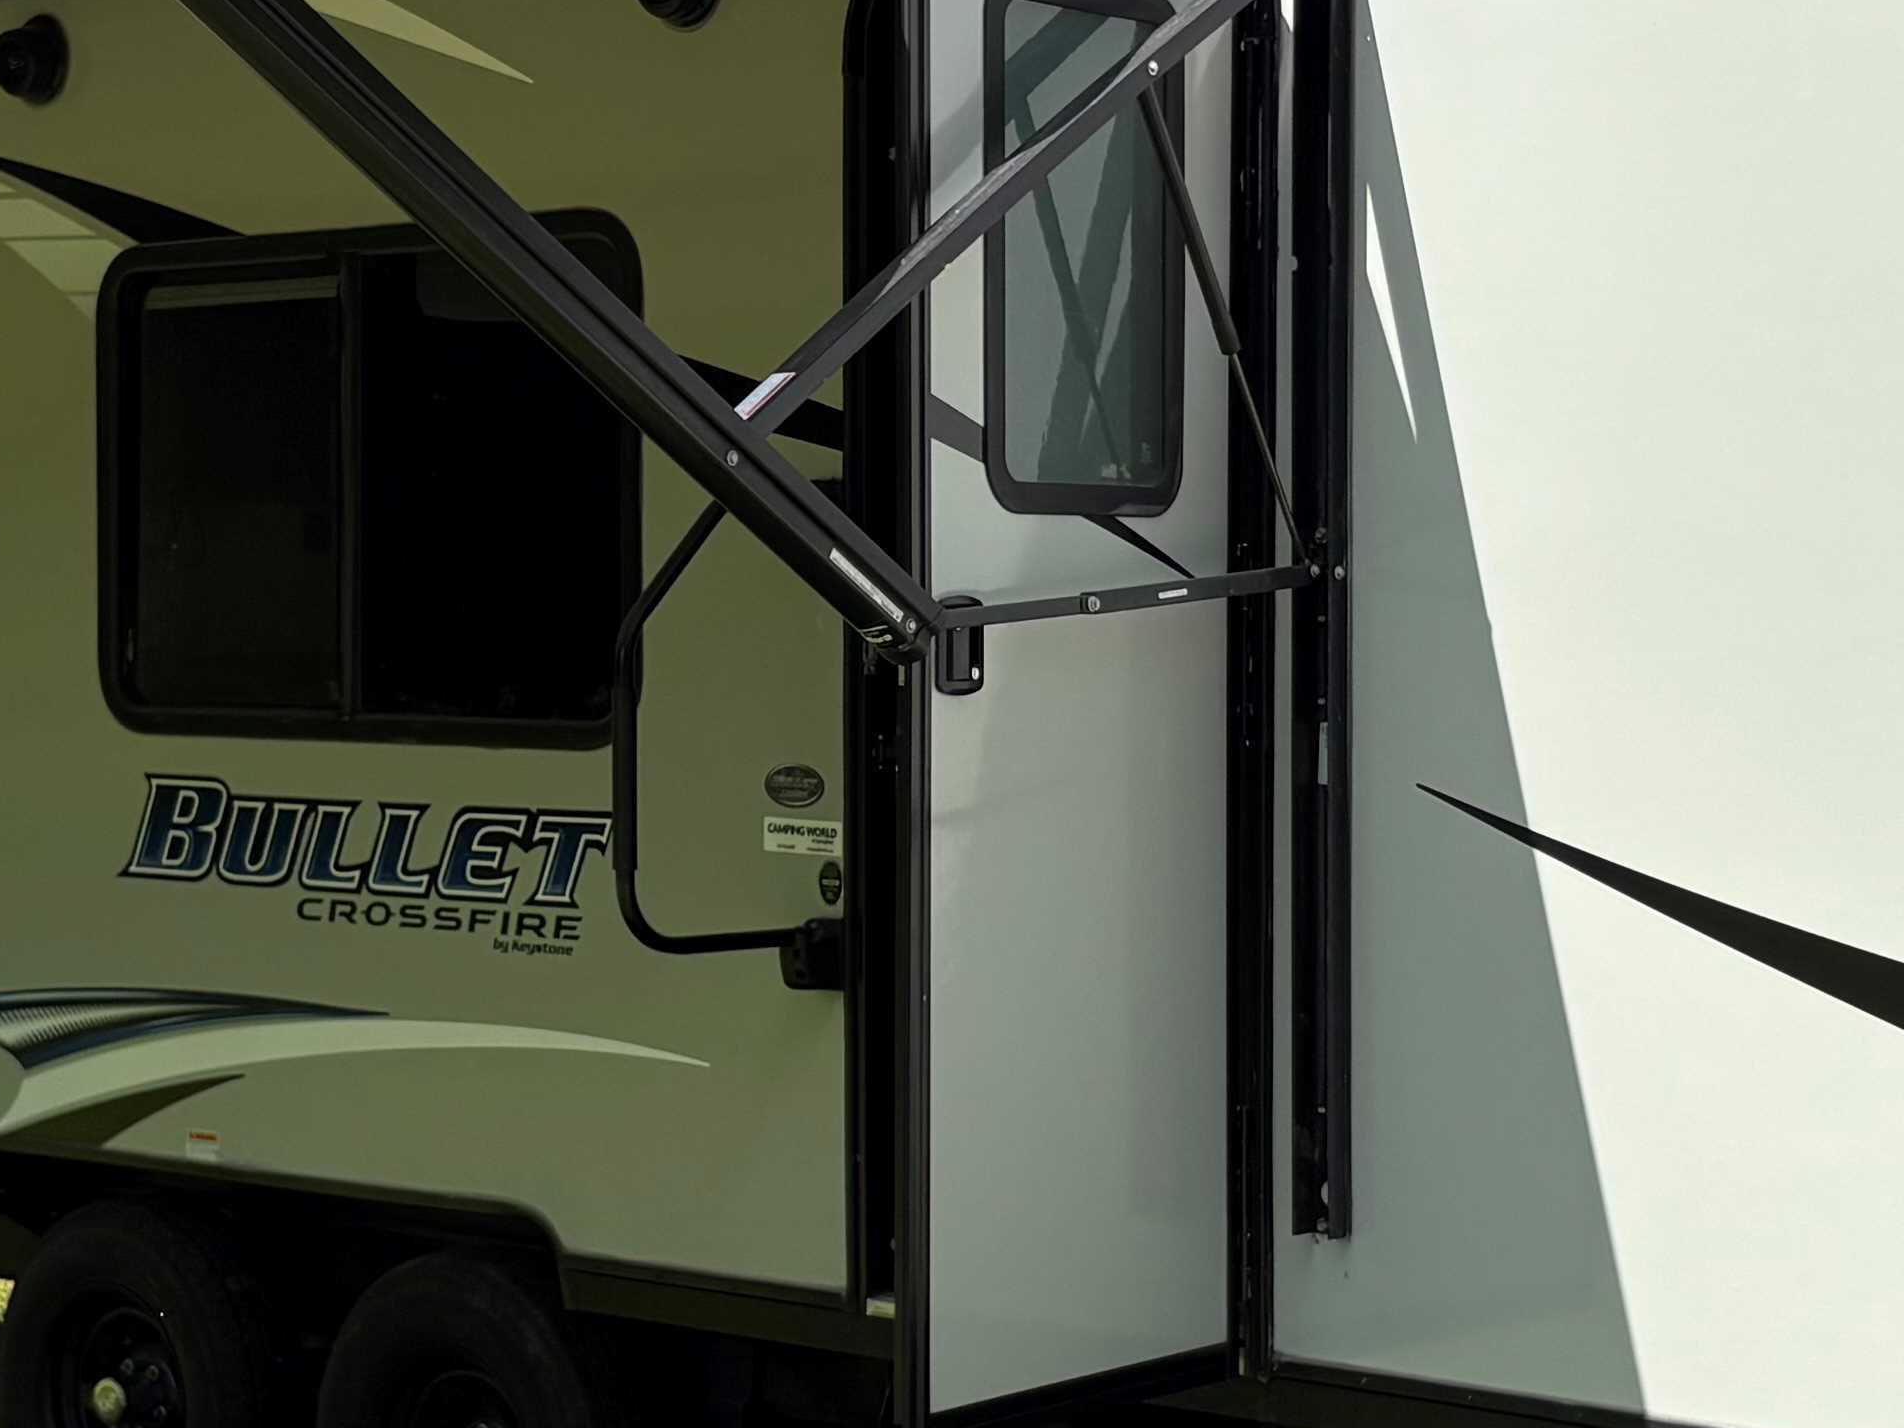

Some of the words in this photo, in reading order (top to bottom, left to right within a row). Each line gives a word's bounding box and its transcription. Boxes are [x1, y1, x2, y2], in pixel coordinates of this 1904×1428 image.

[117, 772, 614, 907] BULLET
[767, 822, 805, 837] CAMPING
[806, 826, 837, 838] WORLD
[296, 897, 582, 941] CROSSFIRE
[492, 937, 509, 954] by
[511, 940, 574, 956] Keystone
